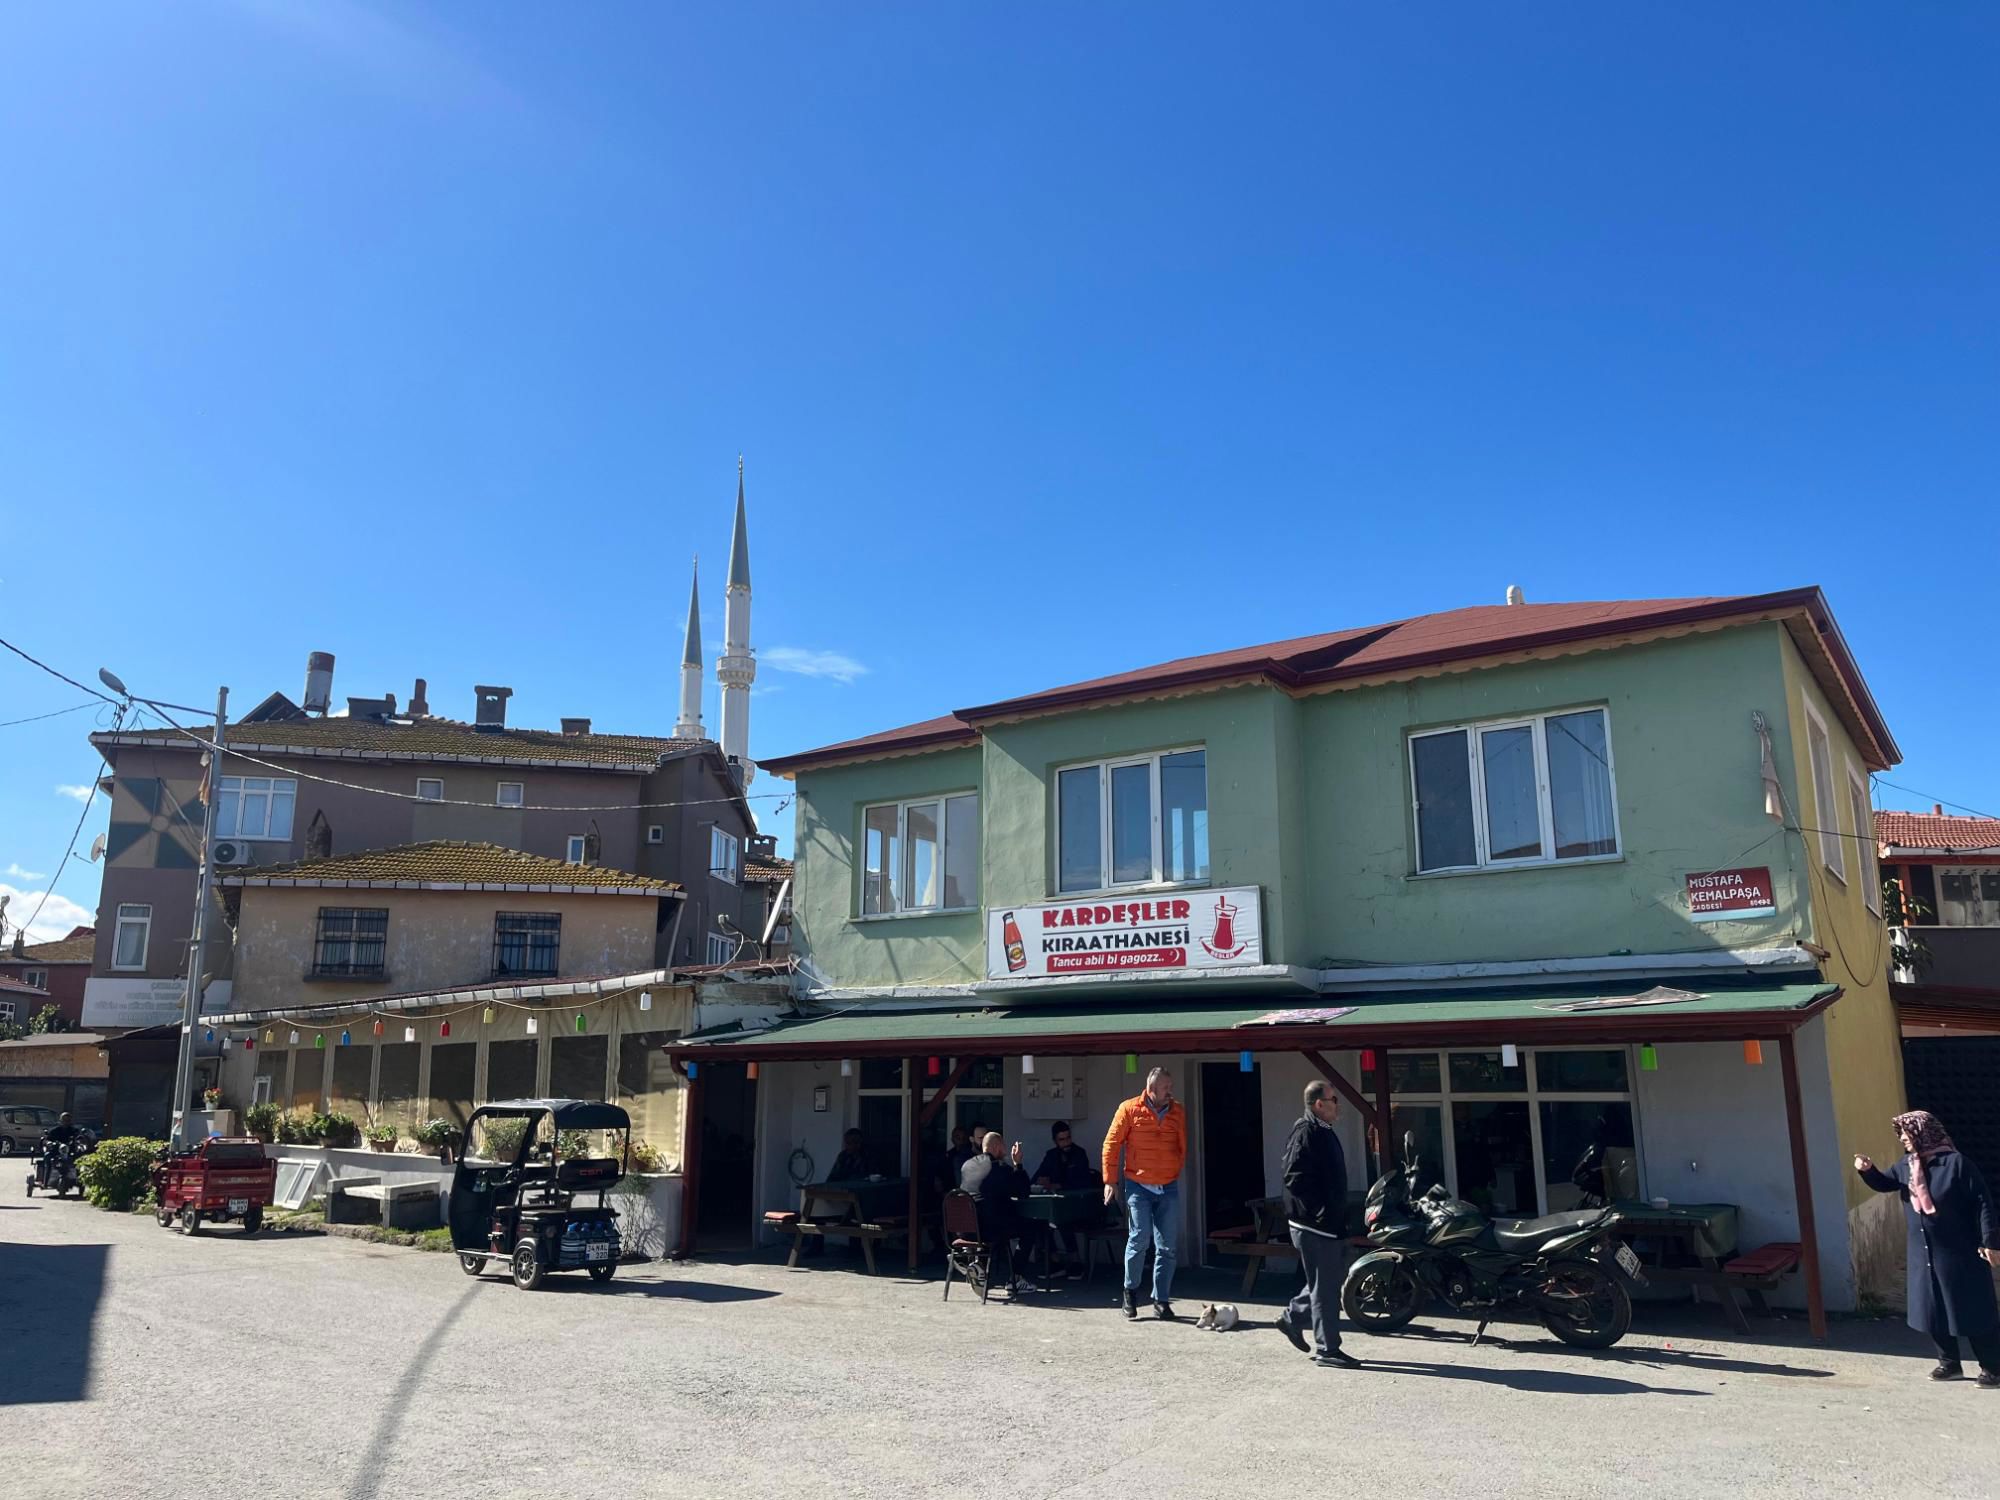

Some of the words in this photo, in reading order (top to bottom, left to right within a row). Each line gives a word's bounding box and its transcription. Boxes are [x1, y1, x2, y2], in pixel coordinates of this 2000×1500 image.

[1689, 874, 1743, 889] MUSTAFA
[1690, 886, 1761, 902] KEMALPAŞA
[1042, 899, 1191, 928] KARDEŞLER
[1042, 926, 1190, 953] KIRAATHANESİ
[1052, 956, 1082, 968] Tancu
